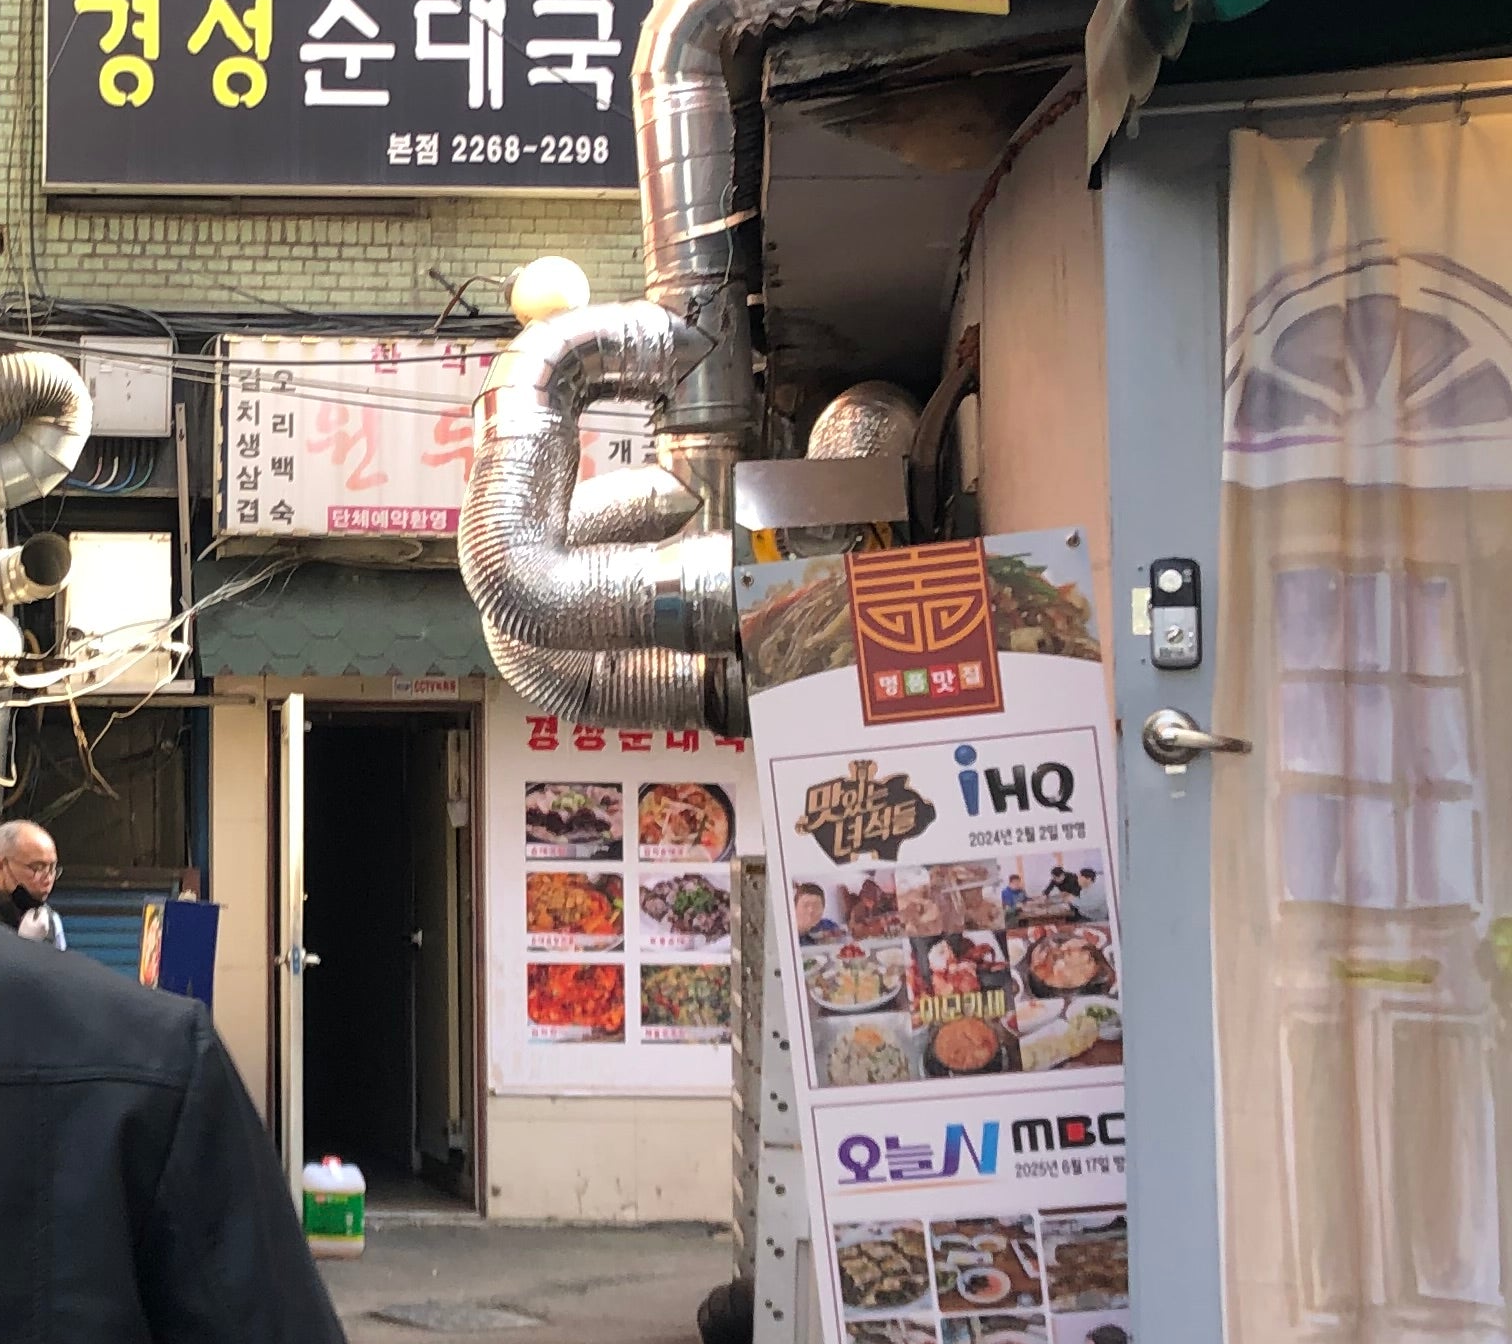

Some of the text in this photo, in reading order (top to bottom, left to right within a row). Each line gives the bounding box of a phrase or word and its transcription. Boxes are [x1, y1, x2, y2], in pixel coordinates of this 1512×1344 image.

[387, 132, 609, 165] 본점 2268-2298
[270, 369, 296, 525] 오리백숙
[954, 744, 1074, 816] iHQ
[1011, 1112, 1125, 1154] MBC
